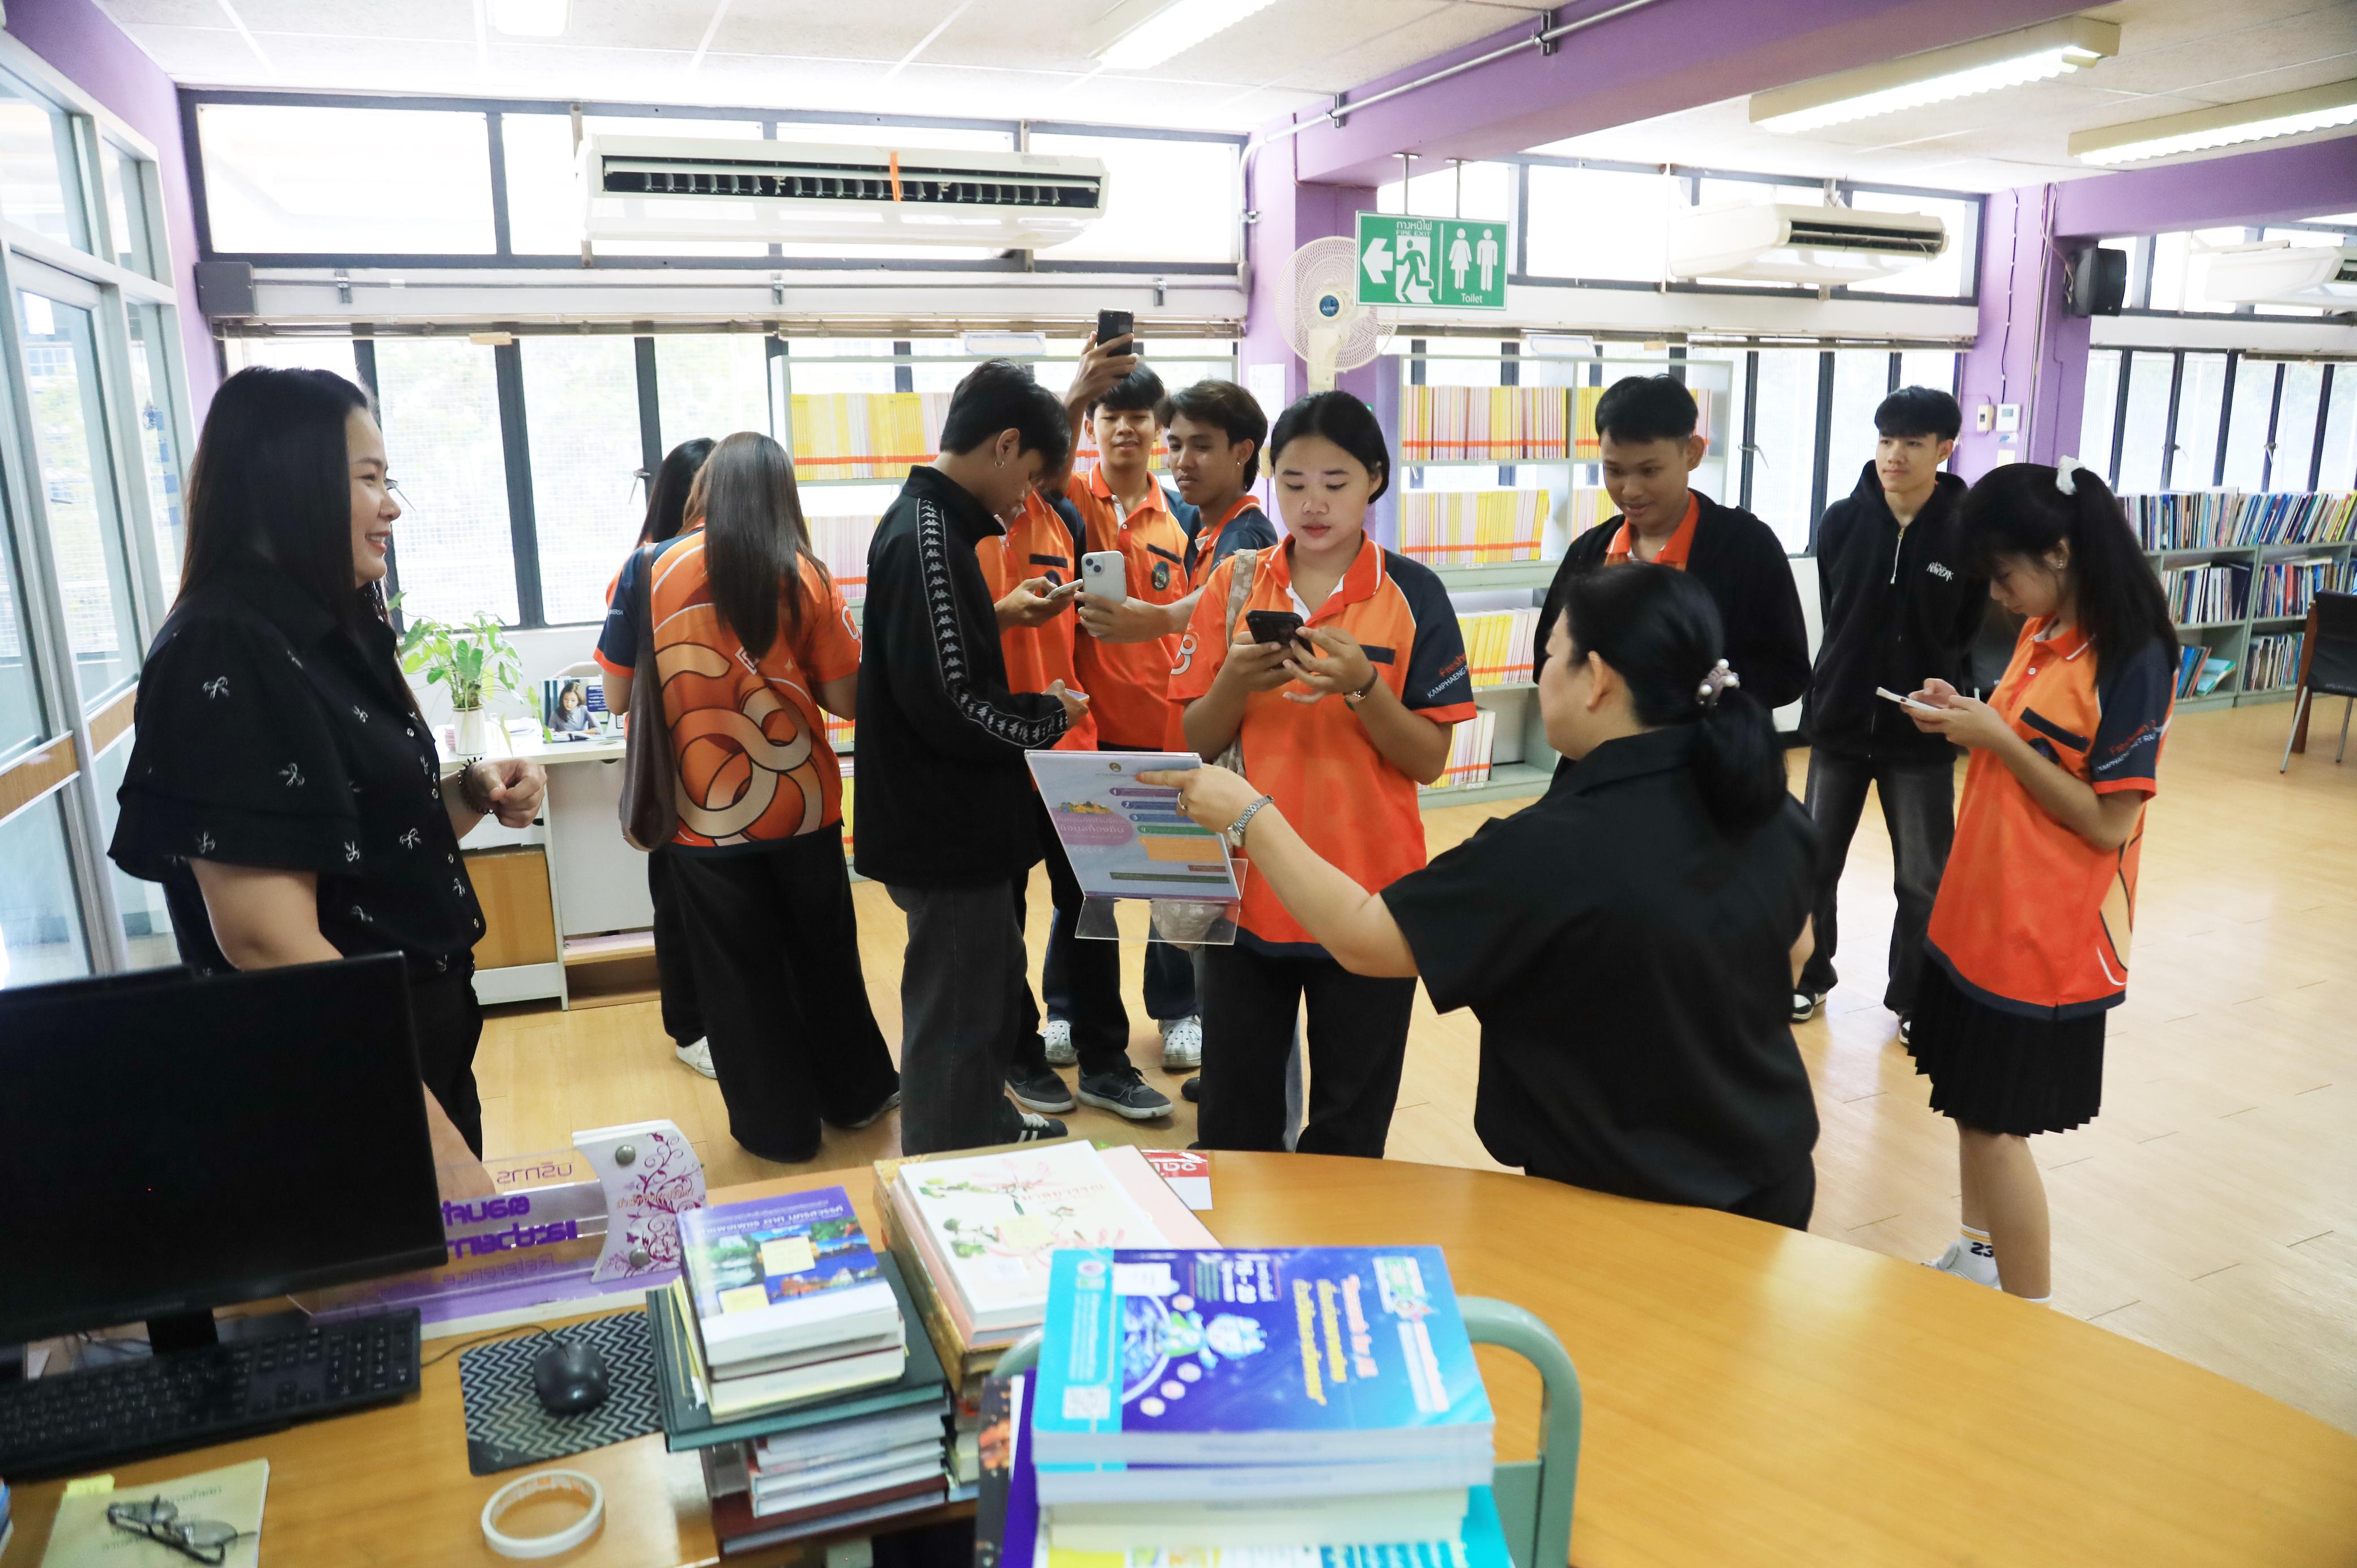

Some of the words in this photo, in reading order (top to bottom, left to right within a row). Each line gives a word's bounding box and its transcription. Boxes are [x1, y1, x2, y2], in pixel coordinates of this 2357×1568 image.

[1461, 292, 1483, 304] Toilet
[1427, 667, 1466, 698] KAMPHAENG
[1971, 1242, 1993, 1258] 23
